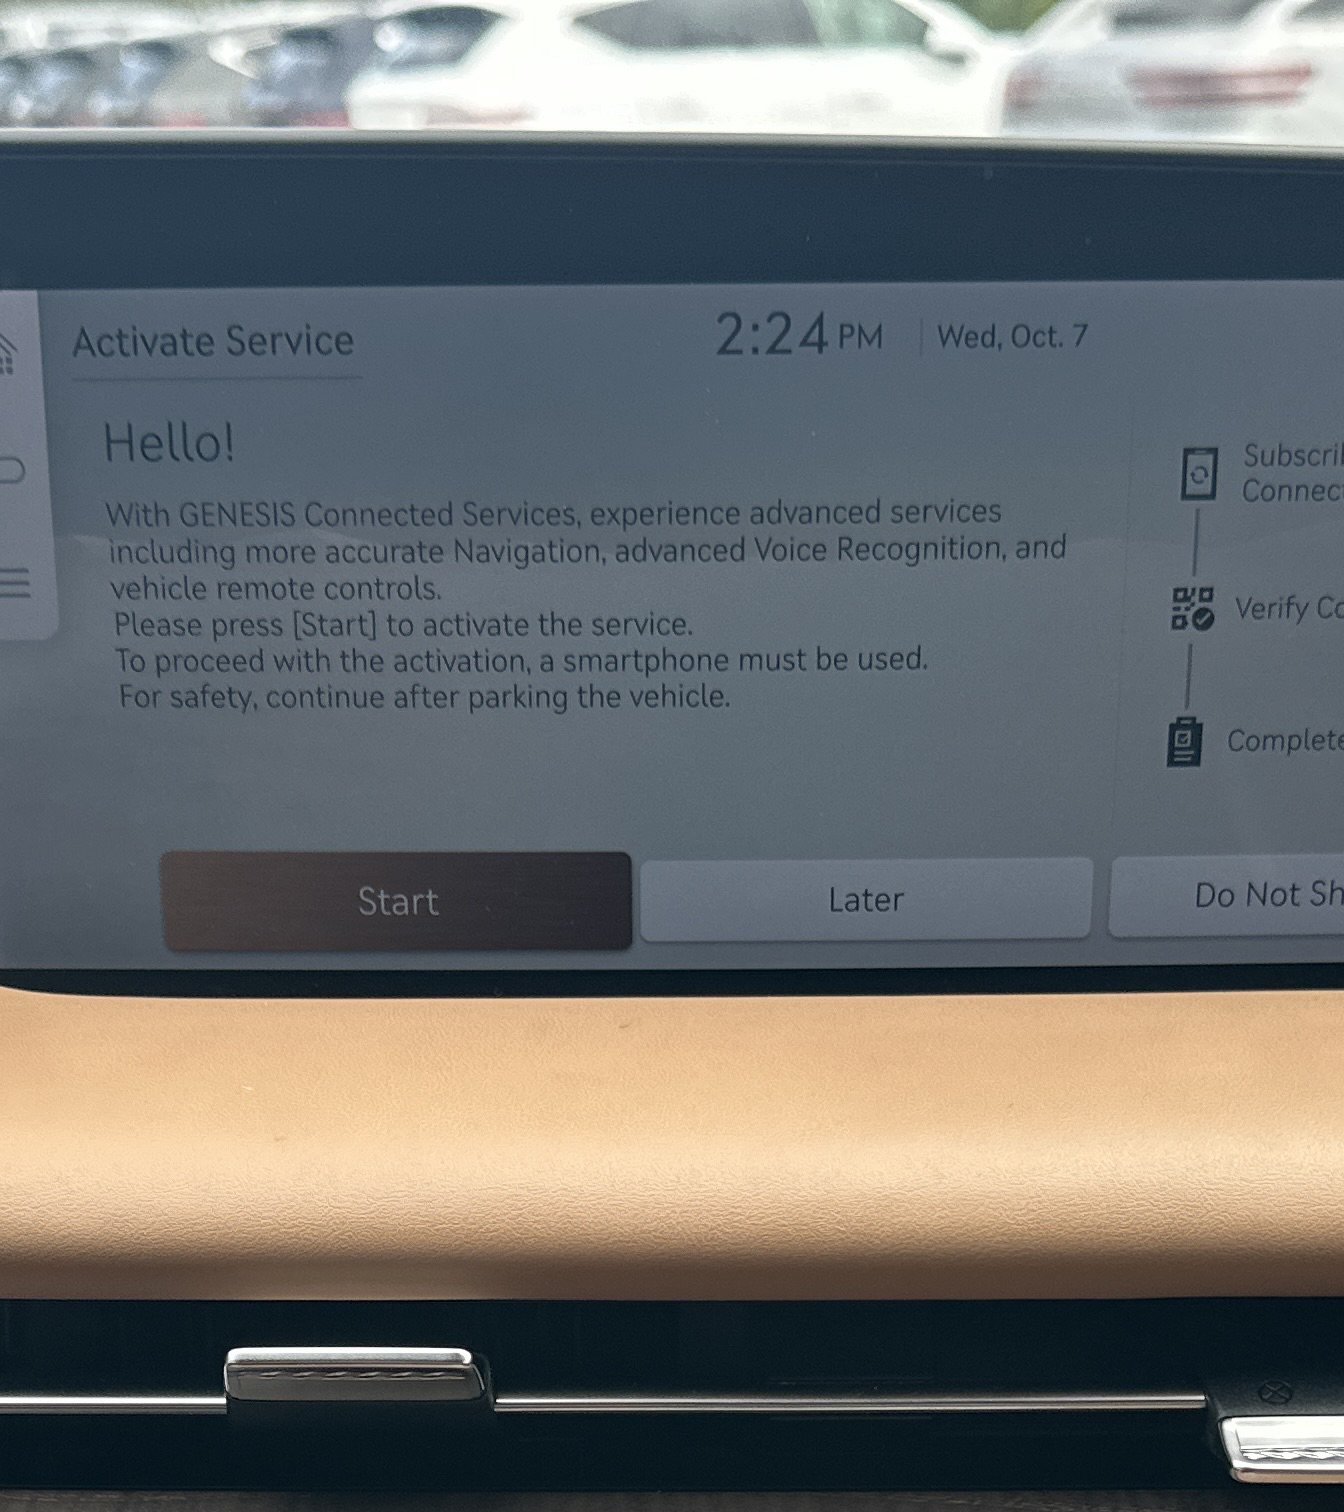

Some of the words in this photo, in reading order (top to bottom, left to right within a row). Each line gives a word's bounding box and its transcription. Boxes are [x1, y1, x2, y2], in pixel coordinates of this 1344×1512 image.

[72, 324, 215, 358] Activate
[226, 323, 354, 357] Service
[716, 310, 829, 356] 2:24
[839, 322, 883, 350] PM
[937, 322, 1003, 352] Wed,
[1010, 323, 1064, 349] Oct.
[1073, 322, 1089, 348] 7
[104, 420, 233, 463] Hello!
[105, 501, 171, 528] With
[179, 501, 296, 528] GENESIS
[304, 500, 453, 528] Connected
[463, 500, 582, 529] Services,
[590, 500, 741, 532] experience
[749, 497, 881, 526] advanced
[890, 497, 1002, 525] services
[110, 537, 236, 571] including
[245, 544, 317, 565] more
[325, 540, 445, 565] accurate
[454, 537, 607, 571] Navigation,
[615, 535, 746, 564] advanced
[753, 536, 828, 562] Voice
[837, 534, 1007, 568] Recognition,
[1015, 532, 1067, 560] and
[109, 574, 207, 601] vehicle
[217, 577, 315, 601] remote
[324, 574, 442, 601] controls.
[115, 611, 203, 637] Please
[212, 617, 284, 643] press
[293, 609, 377, 642] [Start]
[386, 613, 414, 637] to
[423, 611, 530, 637] activate
[537, 610, 583, 637] the
[591, 610, 693, 637] service.
[1235, 593, 1310, 626] Verify
[114, 647, 146, 673] To
[155, 647, 265, 679] proceed
[272, 647, 331, 674] with
[339, 647, 385, 674] the
[393, 647, 532, 676] activation,
[539, 653, 555, 673] a
[563, 646, 729, 679] smartphone
[739, 648, 807, 672] must
[816, 645, 849, 672] be
[858, 644, 928, 671] used.
[119, 683, 162, 709] For
[170, 682, 258, 715] safety,
[266, 684, 385, 709] continue
[393, 682, 460, 709] after
[469, 683, 568, 716] parking
[576, 682, 622, 709] the
[629, 682, 731, 709] vehicle.
[359, 885, 440, 916] Start
[830, 886, 905, 913] Later
[1195, 881, 1236, 908] Do
[1246, 881, 1301, 908] Not
